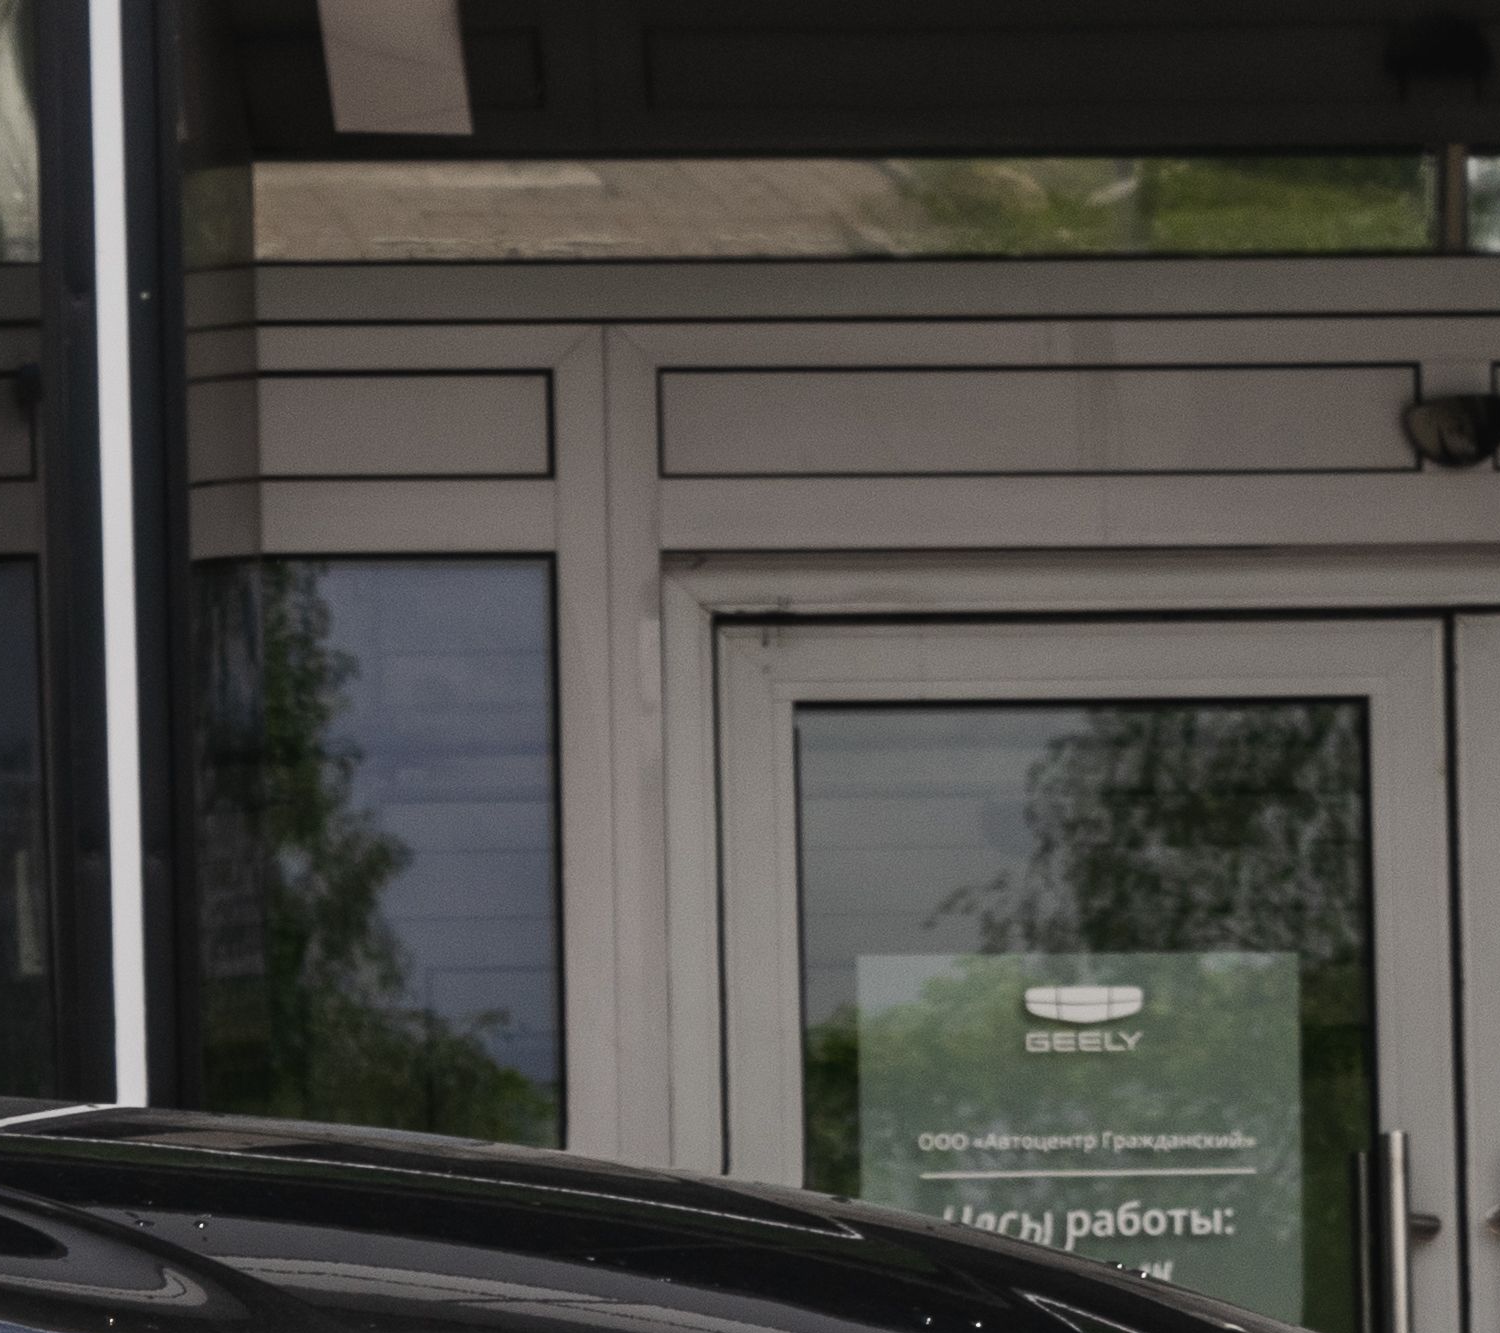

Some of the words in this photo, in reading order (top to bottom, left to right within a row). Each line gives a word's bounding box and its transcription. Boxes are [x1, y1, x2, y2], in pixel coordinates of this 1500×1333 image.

[1025, 1031, 1144, 1052] GEELY
[918, 1132, 969, 1150] ООО
[973, 1132, 1098, 1153] «Автоцентр
[1065, 1200, 1236, 1252] работы:
